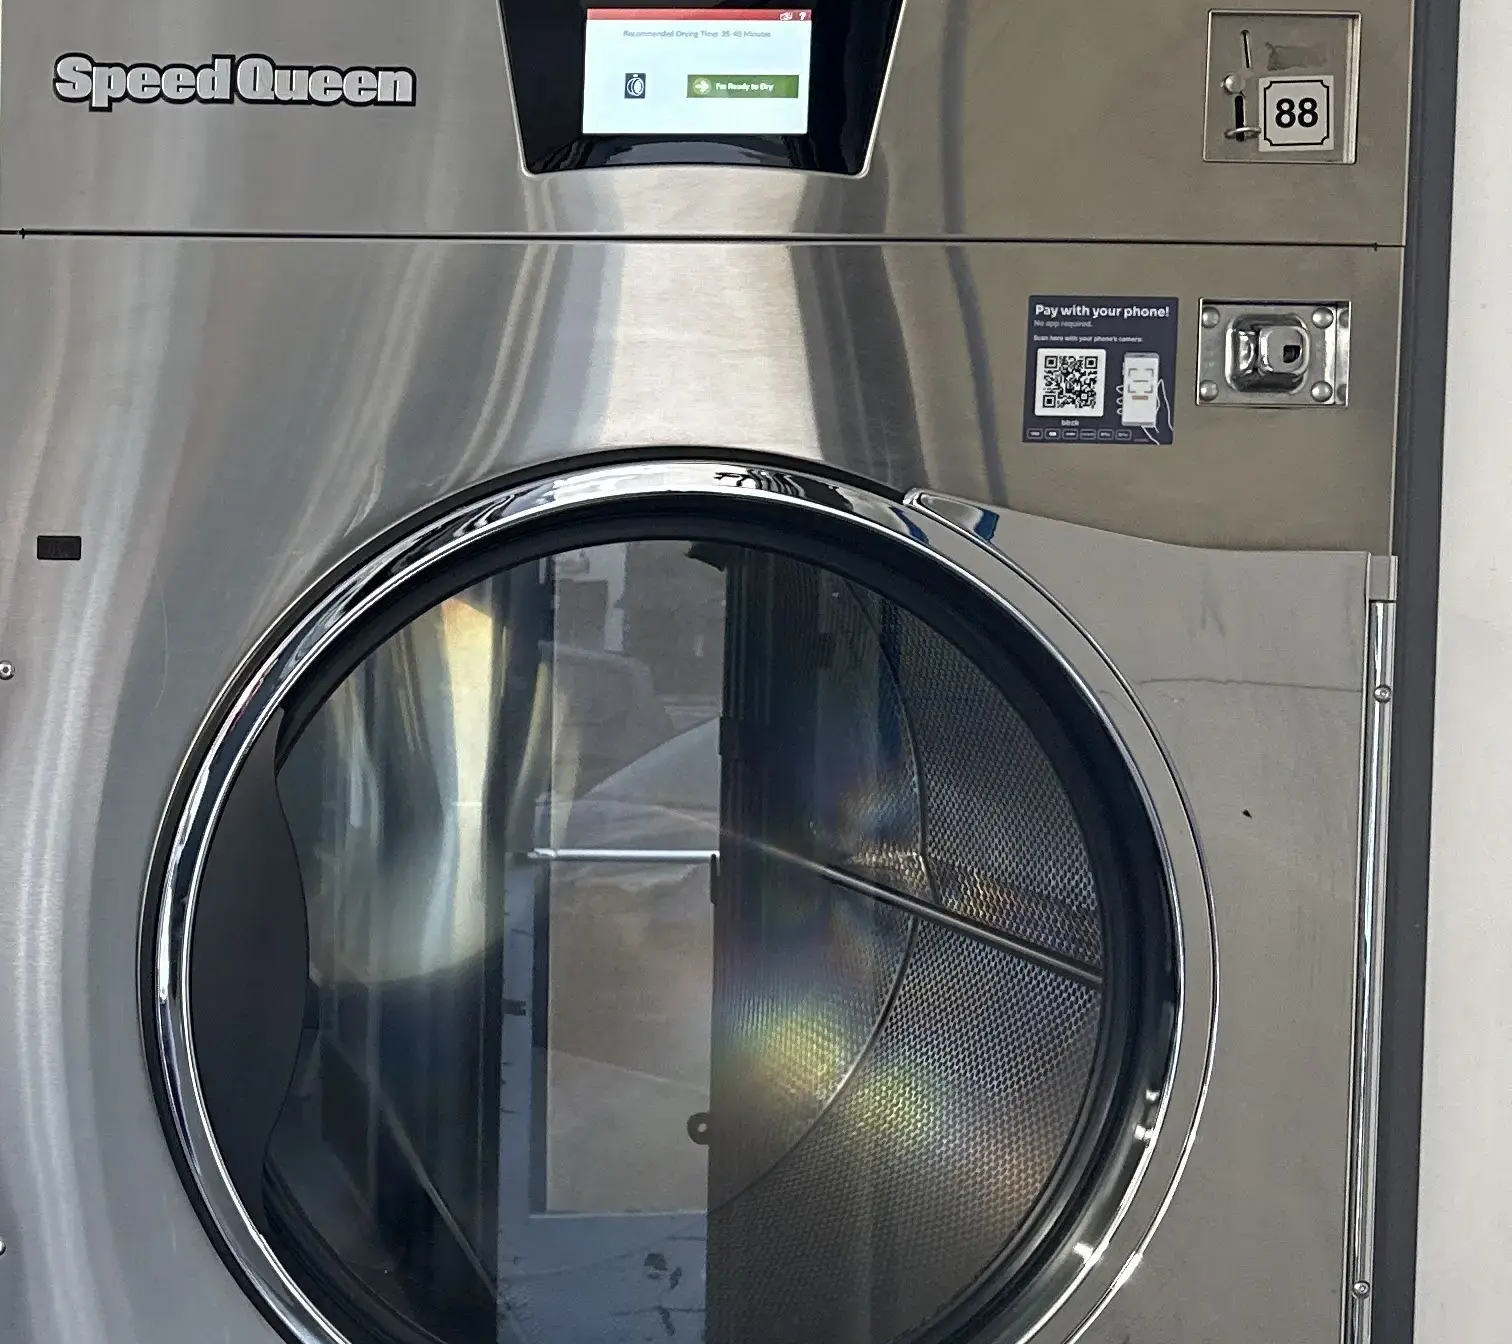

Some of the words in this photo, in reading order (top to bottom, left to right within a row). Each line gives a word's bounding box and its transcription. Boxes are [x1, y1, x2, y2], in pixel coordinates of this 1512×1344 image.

[53, 52, 236, 112] Speed
[235, 53, 416, 106] Queen
[728, 83, 750, 91] Ready
[1275, 97, 1319, 129] 88
[1035, 304, 1058, 318] Pay
[1061, 304, 1089, 316] with
[1092, 307, 1120, 318] your
[1124, 306, 1169, 319] phone!
